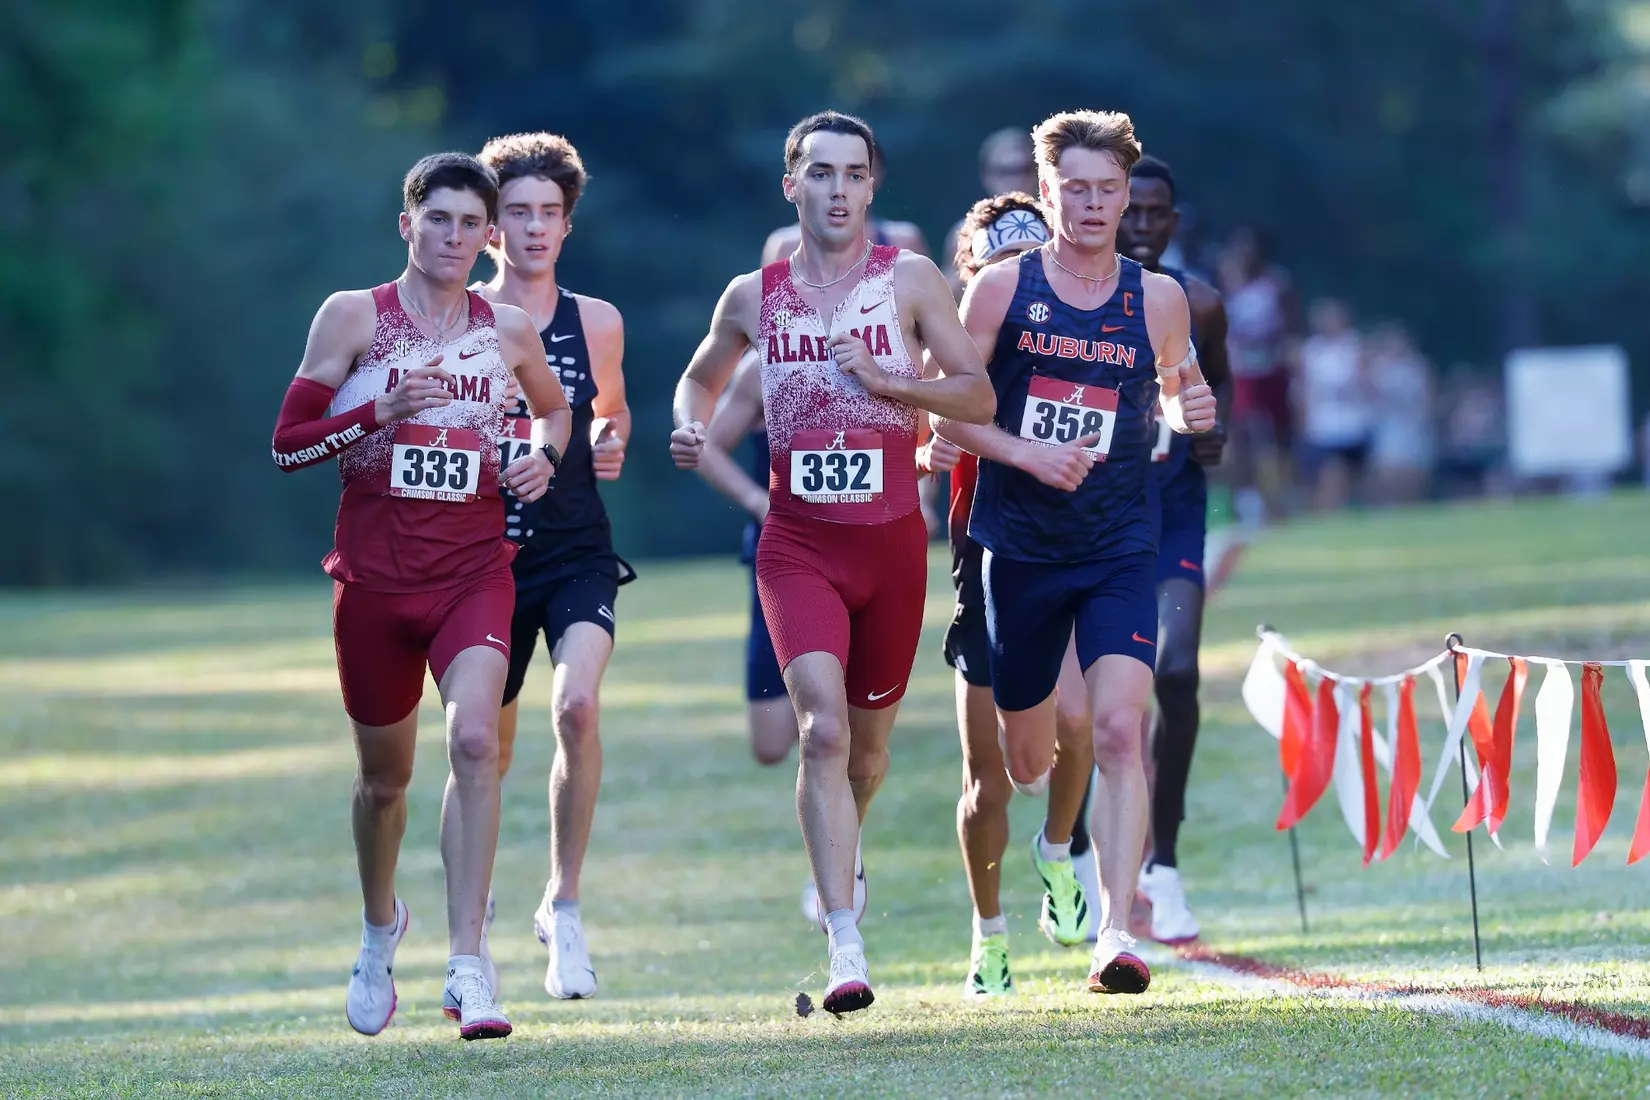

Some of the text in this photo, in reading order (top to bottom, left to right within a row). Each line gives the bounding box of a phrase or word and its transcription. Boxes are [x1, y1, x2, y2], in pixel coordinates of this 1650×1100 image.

[1028, 303, 1049, 322] SEC
[767, 325, 892, 364] ALABMA
[1017, 331, 1136, 369] AUBURN
[1032, 401, 1104, 449] 358
[272, 438, 330, 466] RIMSON
[403, 448, 469, 490] 333
[802, 452, 871, 492] 332
[401, 489, 467, 502] CRIMSON CLASSIC
[802, 493, 873, 504] CRIMSON CLASSIC
